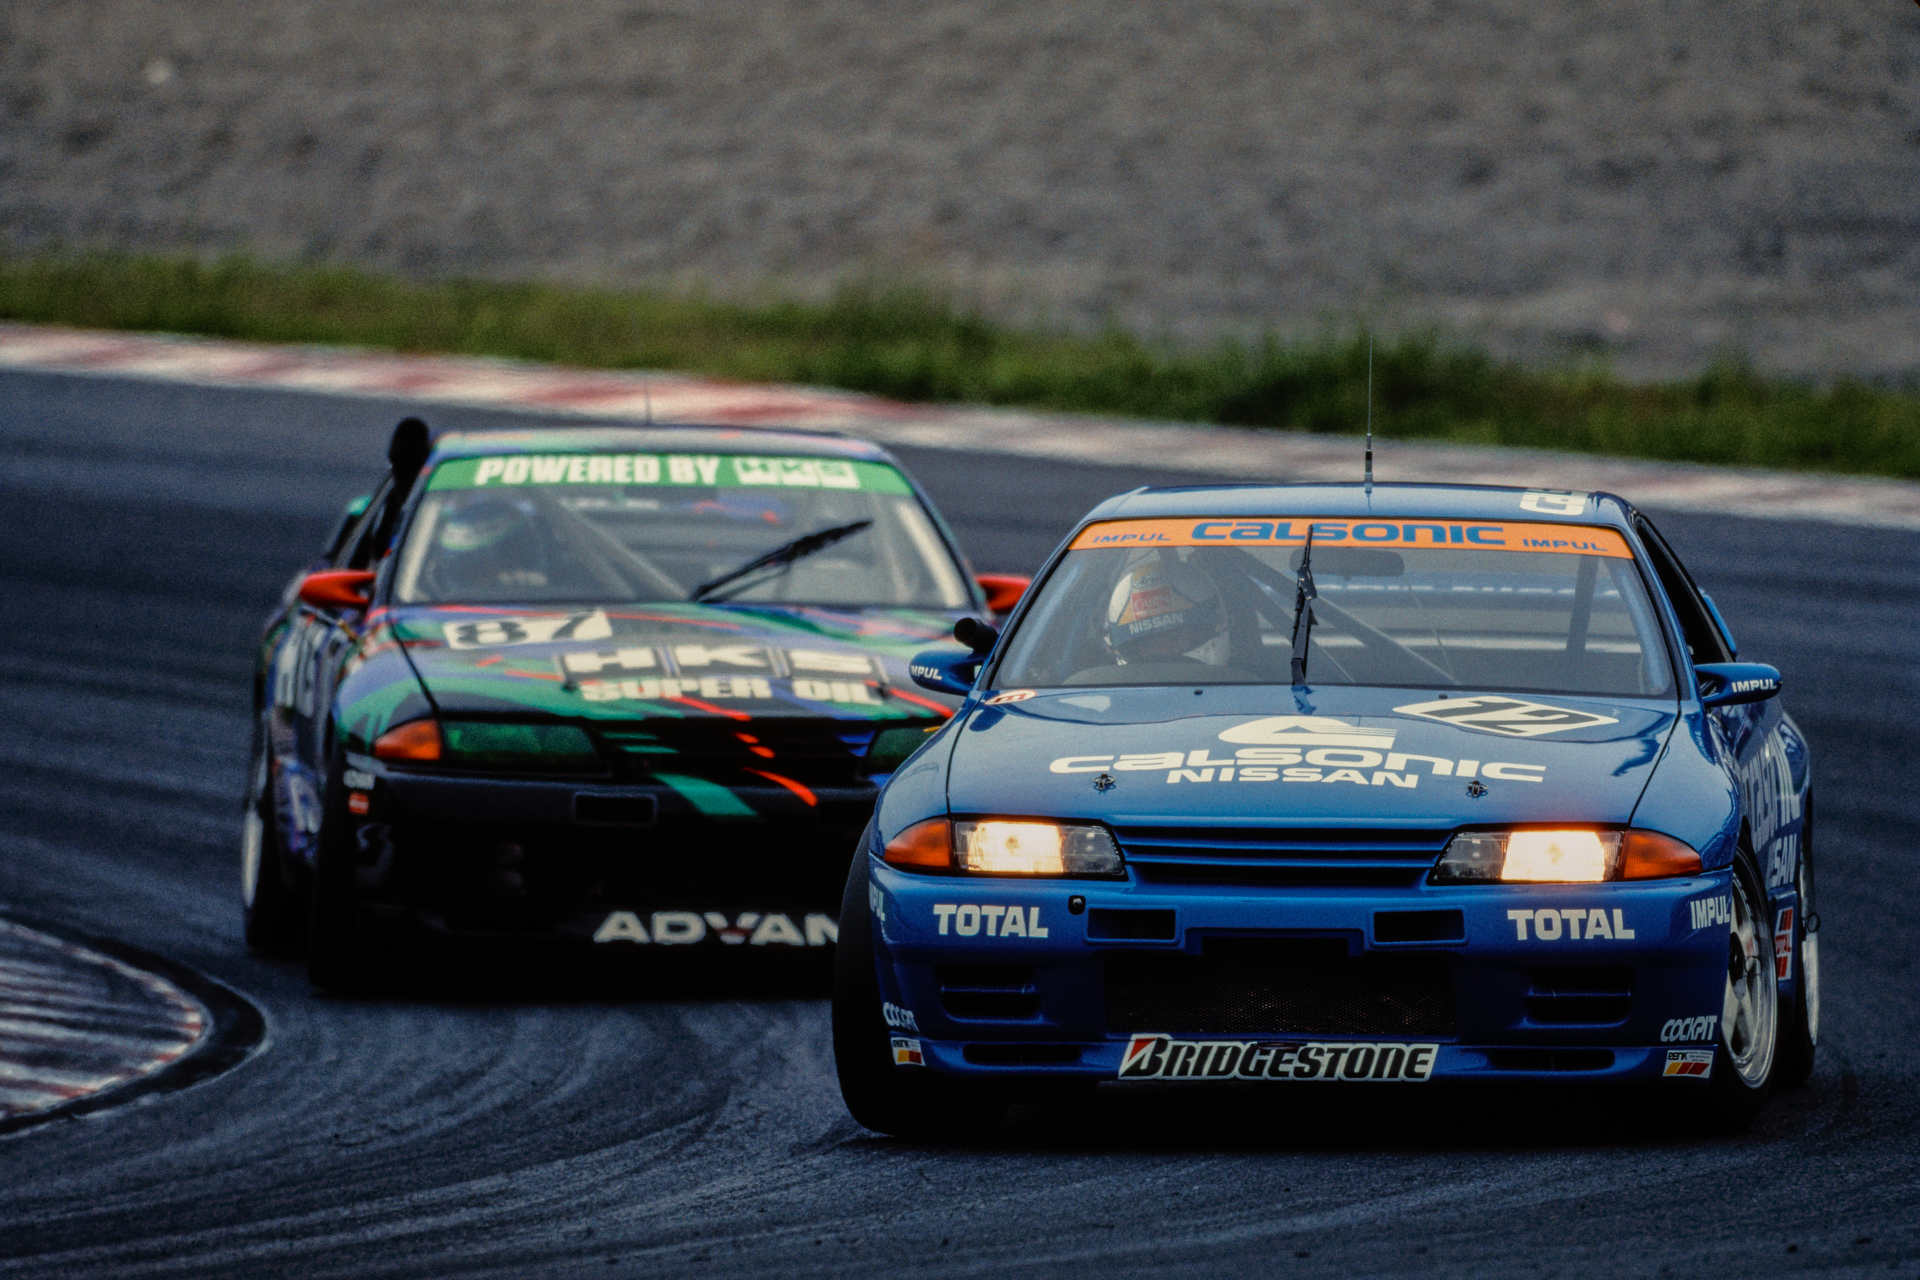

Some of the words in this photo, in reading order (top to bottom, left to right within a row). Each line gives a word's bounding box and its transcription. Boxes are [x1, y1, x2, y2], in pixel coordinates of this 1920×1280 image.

[474, 457, 661, 486] POWERED
[669, 457, 722, 485] BY
[1093, 534, 1172, 545] IMPUL
[1523, 538, 1610, 555] IMPUL
[455, 612, 601, 646] 87
[1129, 613, 1184, 635] NISSAN
[562, 645, 872, 674] HKS
[578, 679, 773, 702] SUPER
[789, 680, 881, 706] OIL
[1731, 678, 1777, 693] IMPUL
[1420, 701, 1600, 734] 12
[1166, 768, 1419, 790] NISSAN
[932, 904, 1050, 939] TOTAL
[1507, 909, 1636, 941] TOTAL
[1690, 895, 1731, 930] IMPUL
[1660, 1015, 1718, 1043] COCKPIT
[1119, 1036, 1437, 1081] BRIDGESTONE
